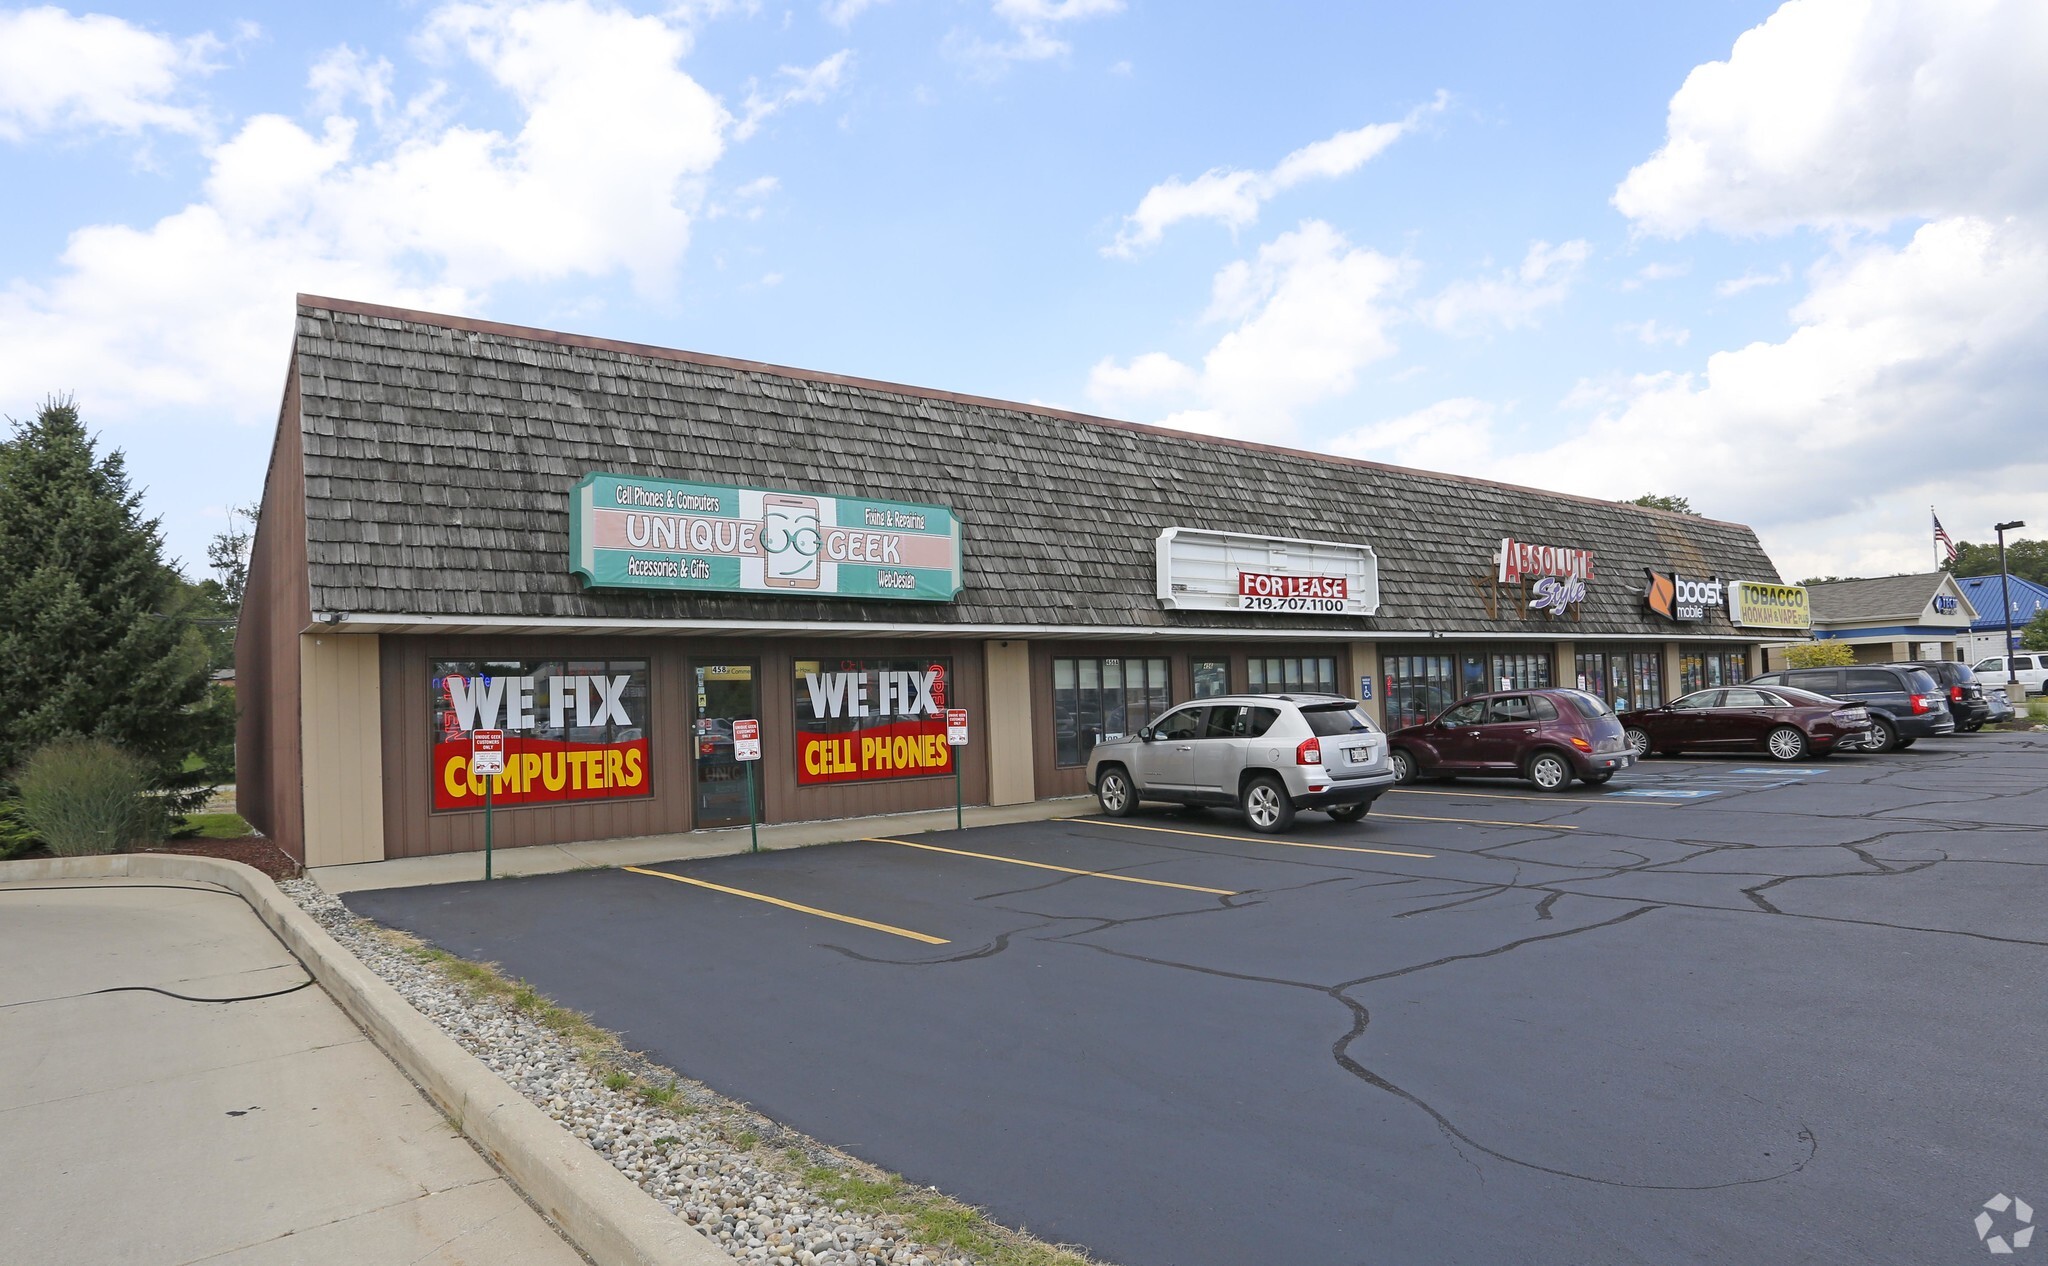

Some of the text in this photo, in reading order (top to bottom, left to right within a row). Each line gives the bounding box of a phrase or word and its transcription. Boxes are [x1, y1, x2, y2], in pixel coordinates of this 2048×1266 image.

[616, 485, 720, 513] Cell Phones & Computers
[865, 507, 925, 530] Fixing & Repairing
[626, 514, 901, 564] UNIQUE GEEK
[628, 555, 710, 580] Accessories & Gifts
[1500, 538, 1595, 583] ABSOLUTE
[1243, 574, 1344, 598] FOR LEASE
[1531, 574, 1586, 616] Style
[1675, 574, 1723, 605] boost
[1742, 585, 1803, 608] TOBACCO
[1244, 596, 1344, 612] 219.707.1100
[1677, 605, 1703, 618] mobile
[1742, 606, 1773, 624] HOOKAH
[1774, 611, 1779, 622] &
[1778, 609, 1797, 624] VAPE
[712, 666, 727, 674] 458
[447, 676, 535, 731] WE
[549, 675, 633, 728] FIX
[805, 672, 869, 718] WE
[879, 671, 939, 716] FIX
[805, 733, 948, 776] CELL PHONES
[444, 748, 643, 798] COMPUTERS
